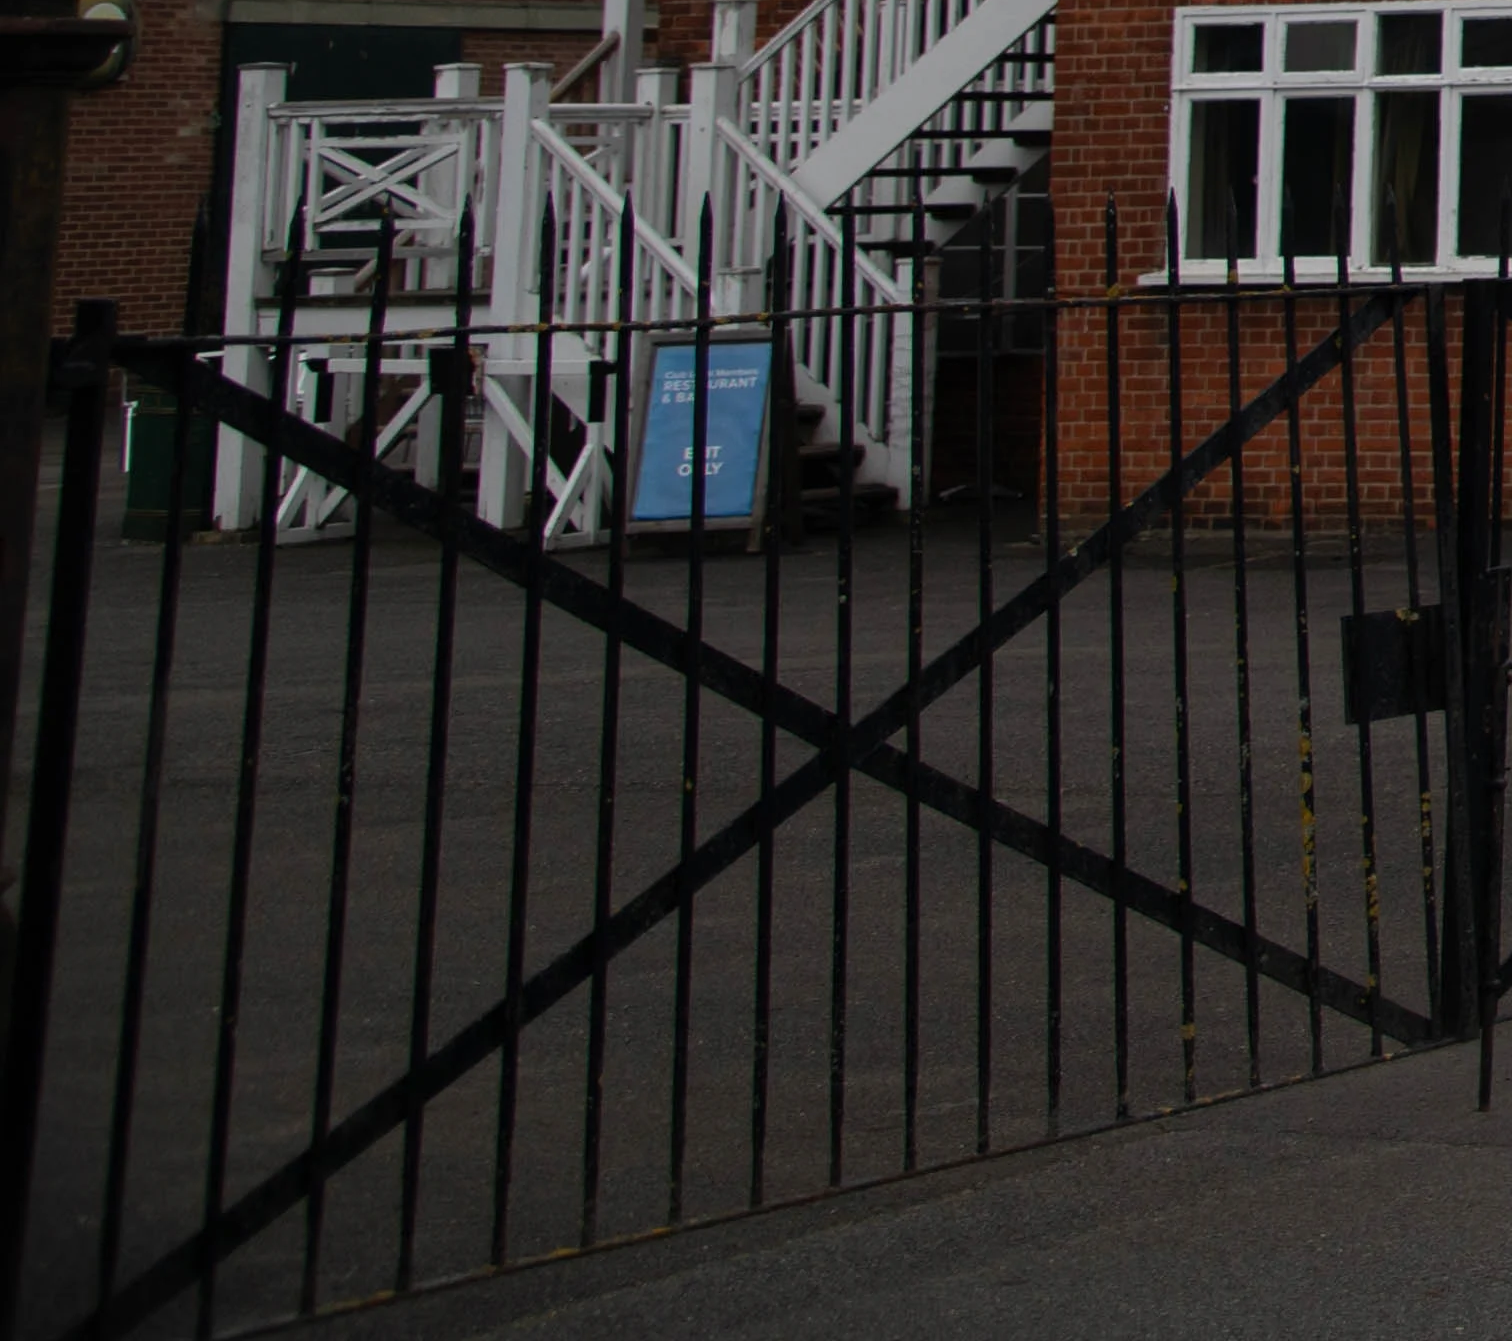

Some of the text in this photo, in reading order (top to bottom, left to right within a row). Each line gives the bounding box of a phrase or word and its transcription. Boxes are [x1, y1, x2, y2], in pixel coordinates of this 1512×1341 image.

[663, 377, 758, 391] RESTURANT
[682, 445, 722, 461] EIT
[677, 462, 724, 477] OLY
